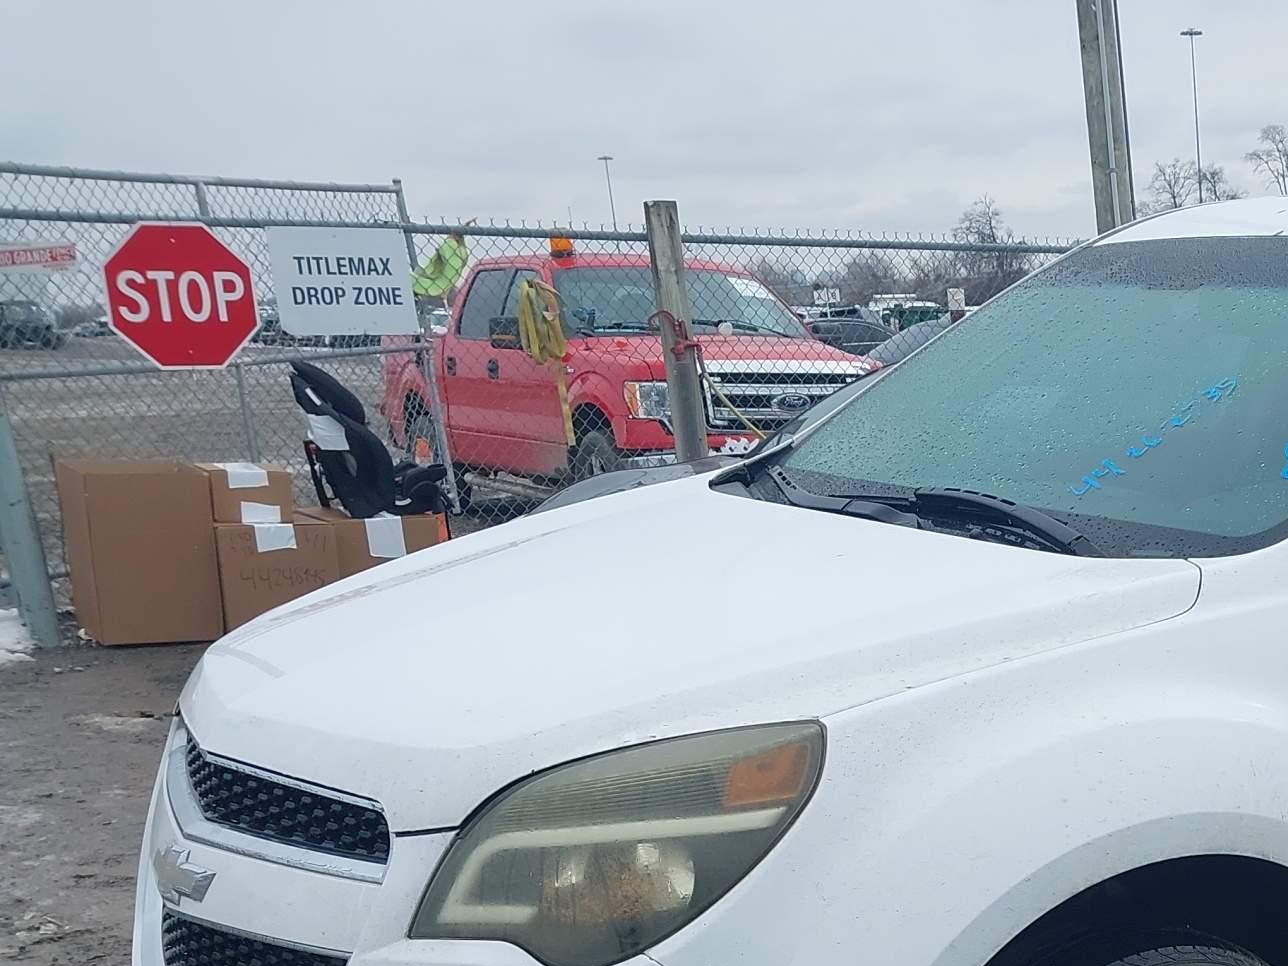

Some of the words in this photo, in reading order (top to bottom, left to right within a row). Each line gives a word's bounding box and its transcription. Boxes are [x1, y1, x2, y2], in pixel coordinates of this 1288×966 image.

[292, 256, 393, 276] TITLEMAX
[116, 269, 246, 323] STOP
[291, 286, 346, 306] DROP
[352, 286, 404, 306] ZONE
